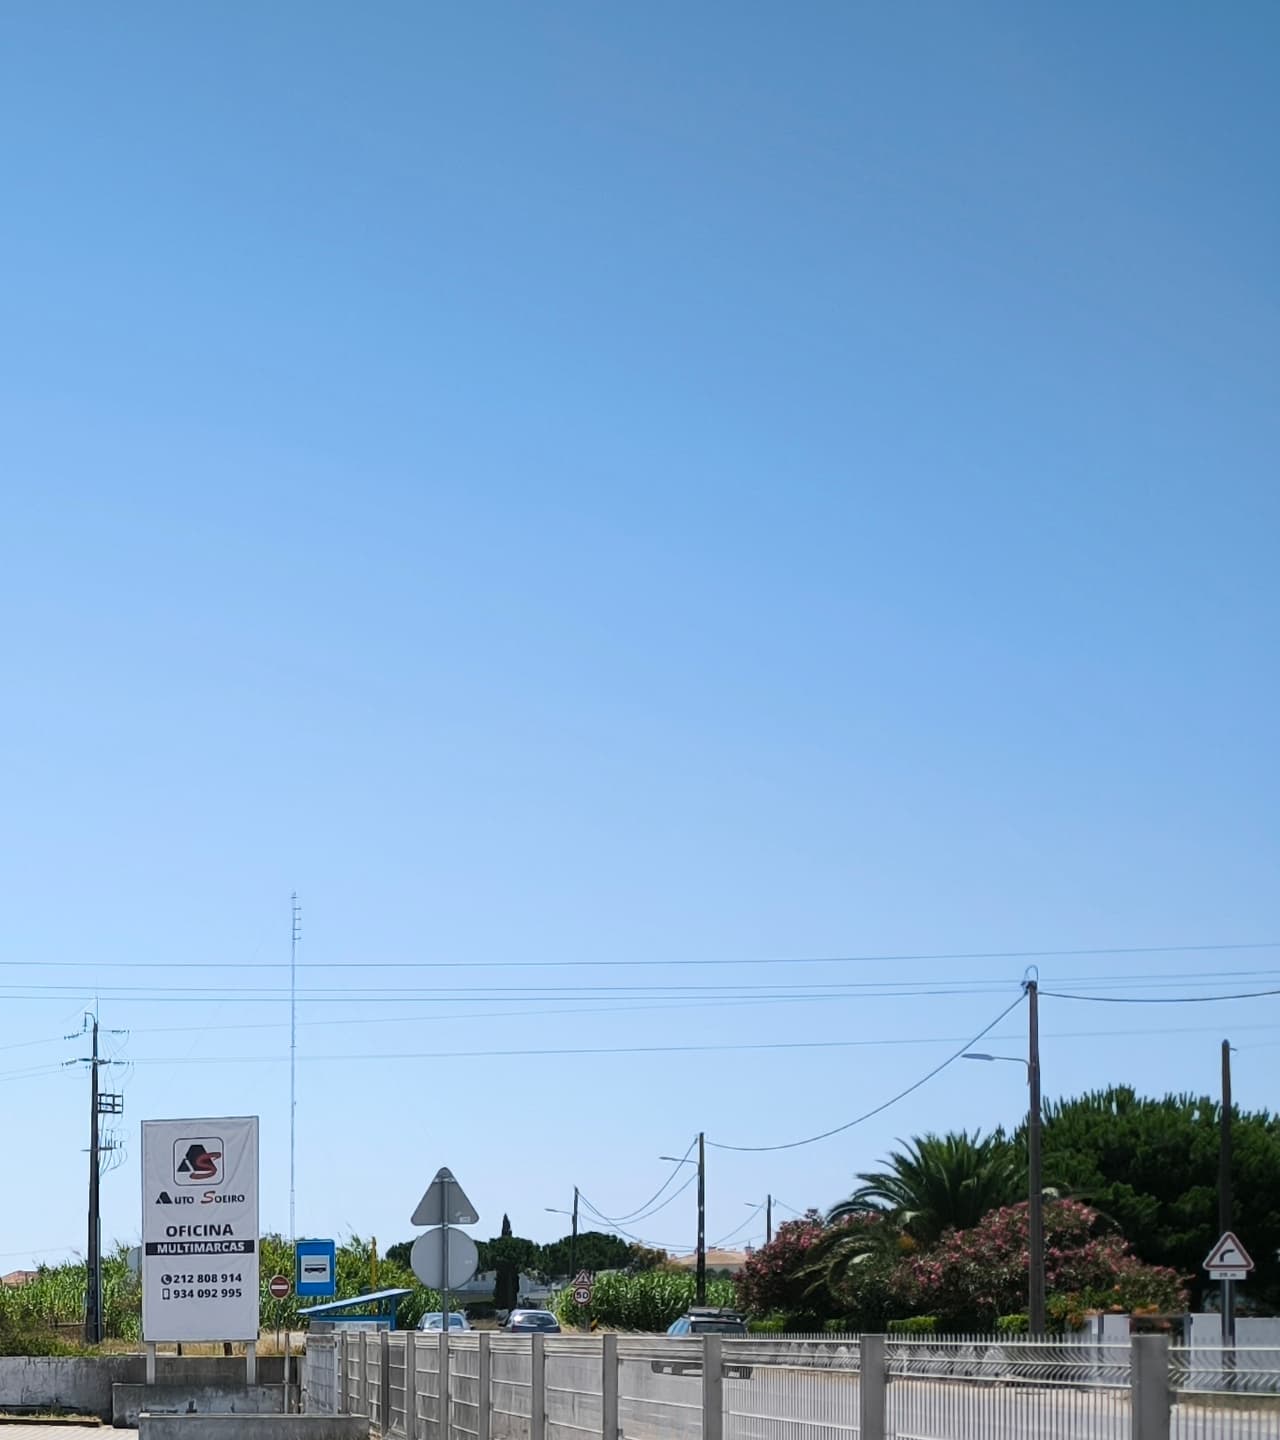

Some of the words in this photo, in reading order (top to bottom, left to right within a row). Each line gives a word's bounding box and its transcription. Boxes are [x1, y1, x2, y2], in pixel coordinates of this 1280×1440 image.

[155, 1191, 195, 1205] AUTO
[200, 1190, 246, 1205] SOEIRO
[165, 1223, 234, 1238] OFICINA
[156, 1241, 245, 1254] MULTIMARCAS
[172, 1273, 195, 1284] 212
[196, 1273, 218, 1284] 808
[220, 1272, 243, 1283] 914
[172, 1288, 195, 1299] 934
[197, 1288, 218, 1299] 092
[220, 1288, 243, 1298] 995
[576, 1291, 589, 1299] 50
